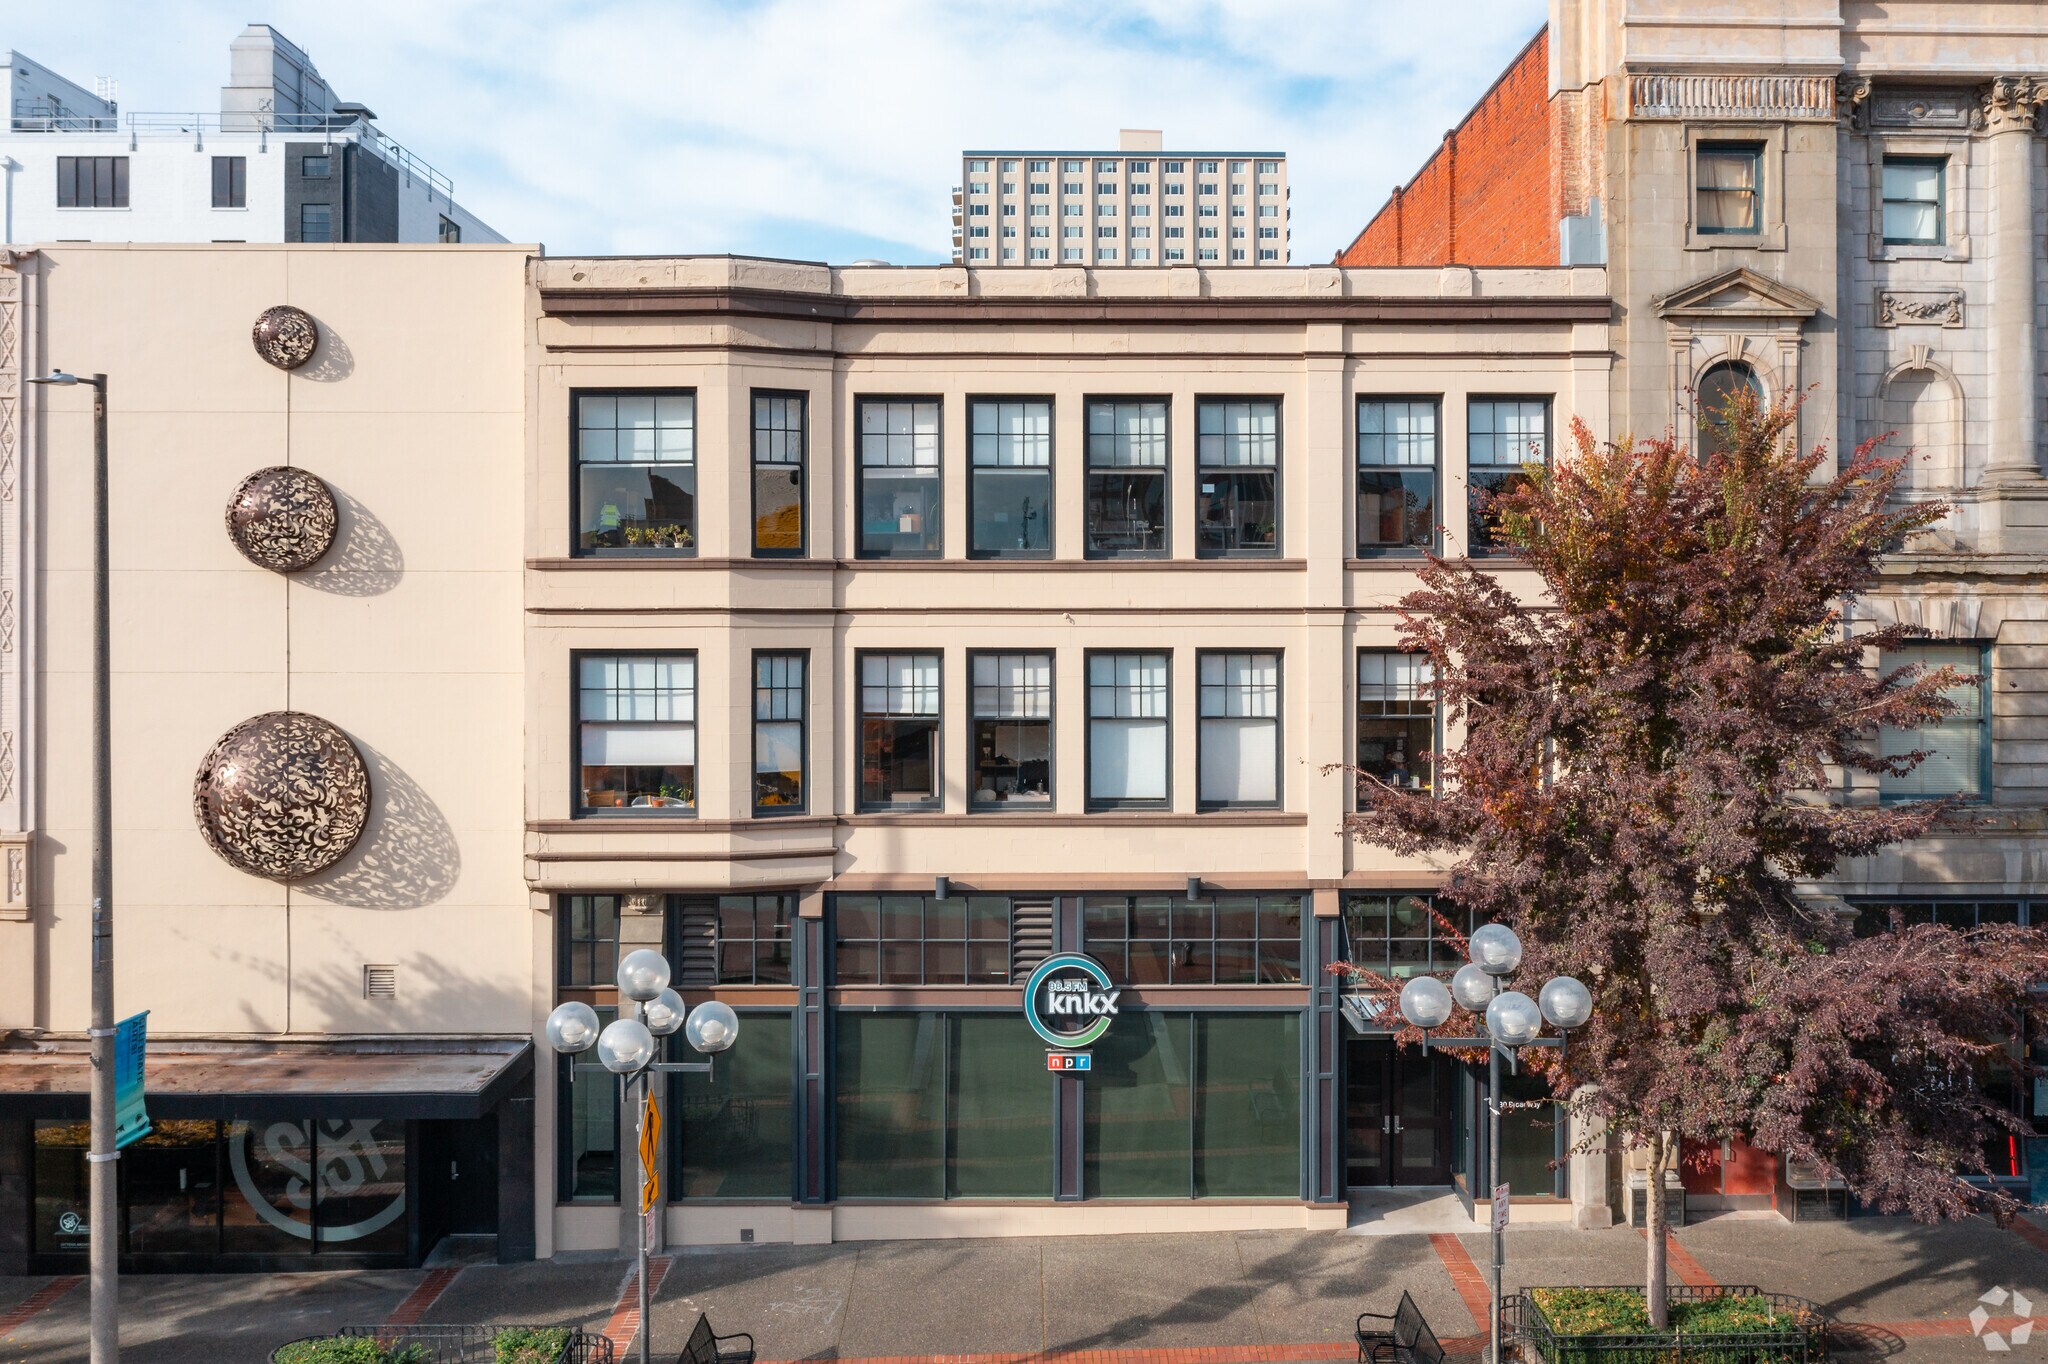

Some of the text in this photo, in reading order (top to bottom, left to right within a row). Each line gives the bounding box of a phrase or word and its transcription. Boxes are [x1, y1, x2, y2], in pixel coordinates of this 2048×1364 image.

[1048, 980, 1088, 991] 88.5 FM
[1048, 991, 1120, 1014] knkx
[136, 1017, 146, 1084] CELEBRATE
[1052, 1058, 1086, 1069] npr
[1508, 1100, 1541, 1109] Boawy
